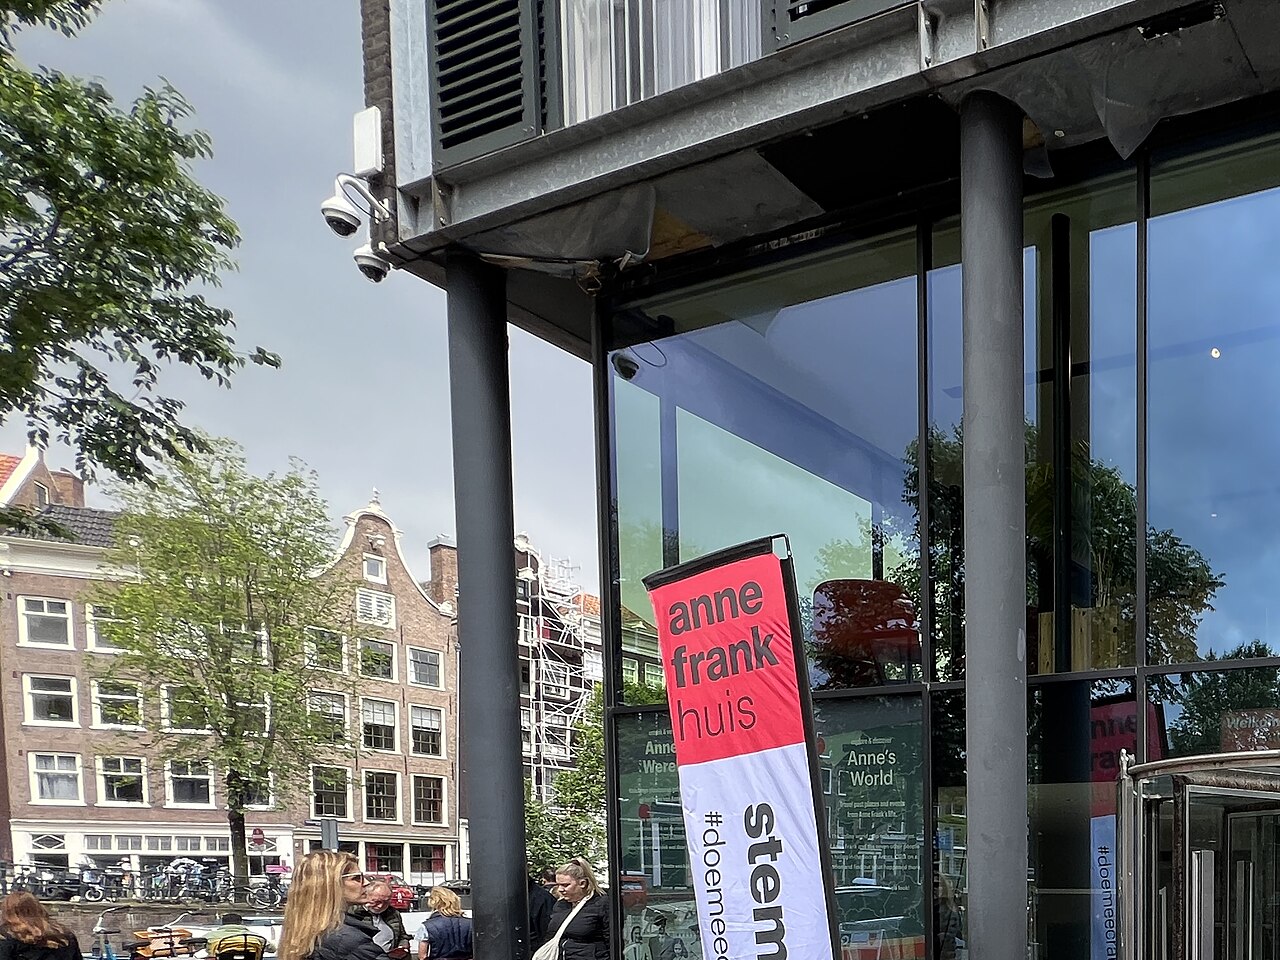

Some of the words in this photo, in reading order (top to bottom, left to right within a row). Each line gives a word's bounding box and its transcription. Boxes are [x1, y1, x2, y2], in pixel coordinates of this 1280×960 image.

[669, 580, 763, 635] anne
[672, 626, 779, 688] frank
[677, 689, 757, 741] huis
[646, 741, 677, 755] Anne
[848, 750, 896, 766] Anne's
[642, 761, 676, 774] Were
[850, 770, 893, 786] World
